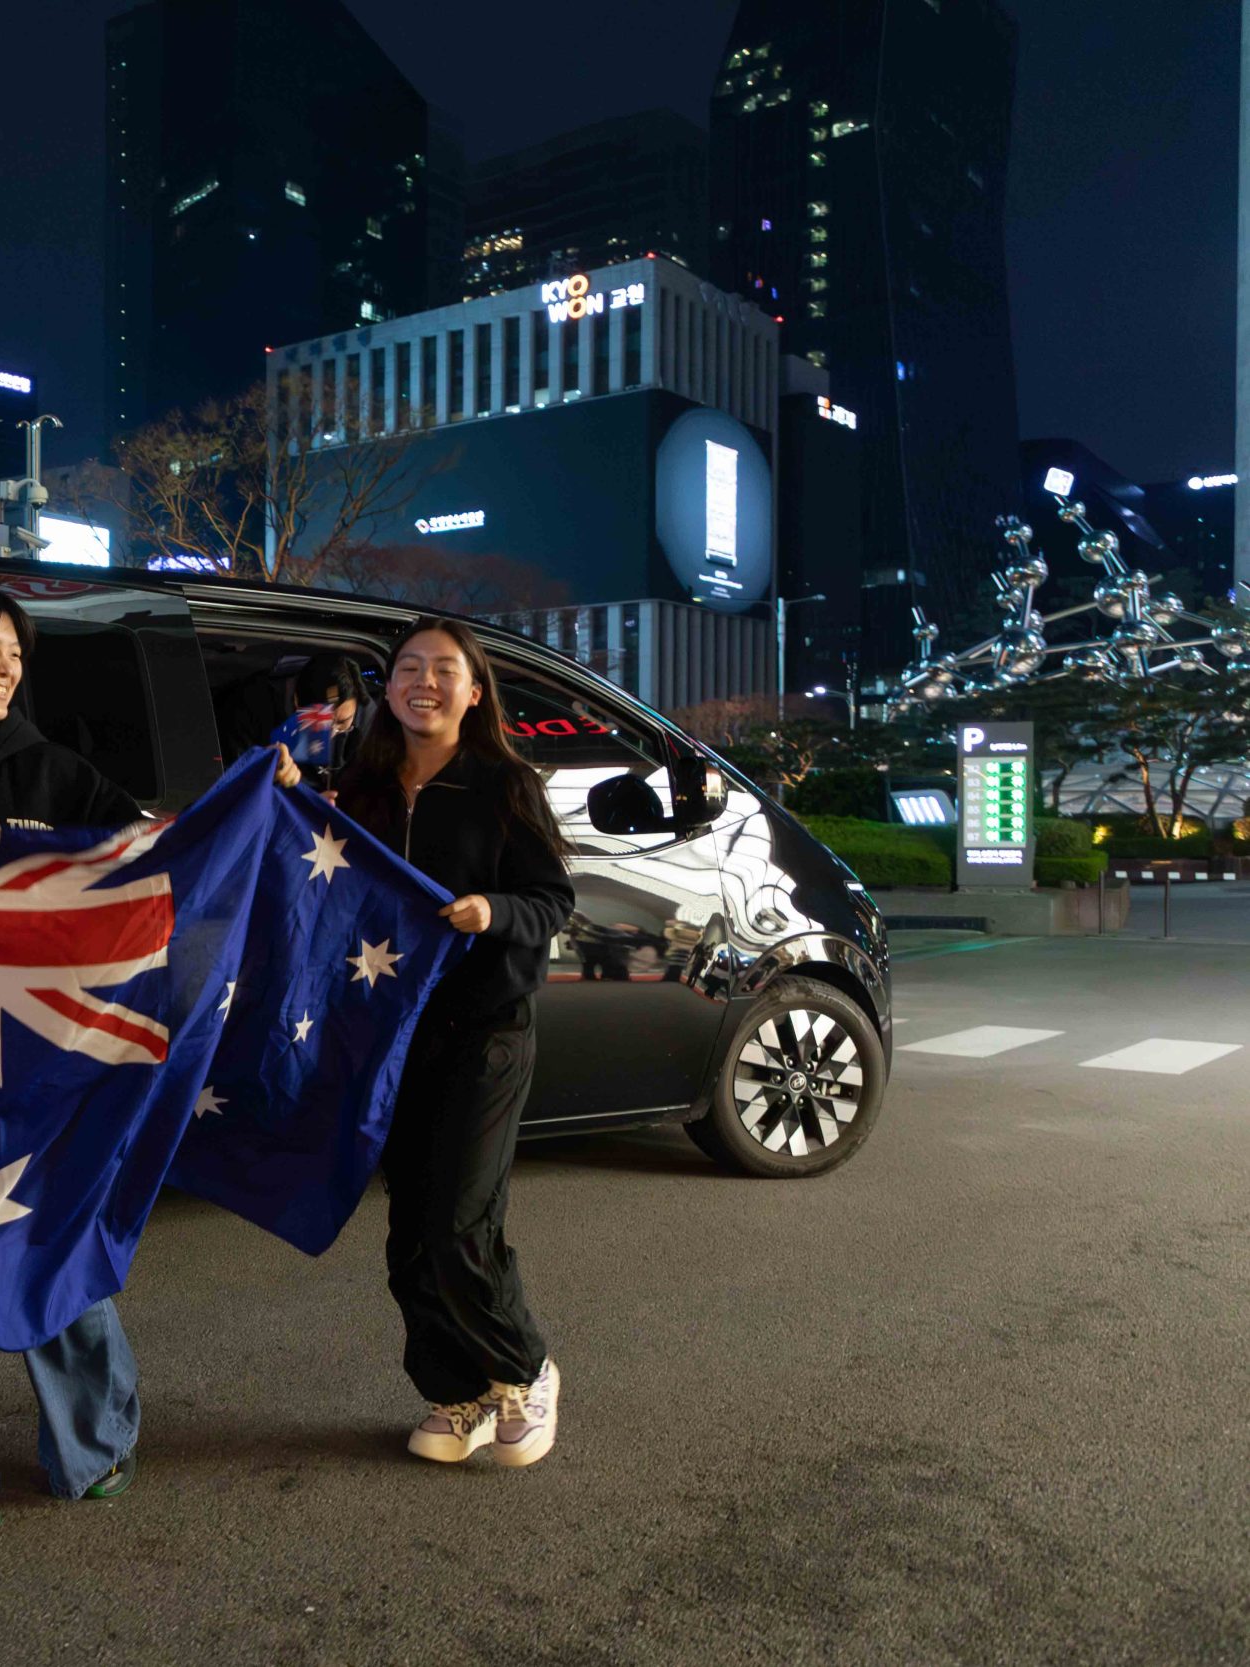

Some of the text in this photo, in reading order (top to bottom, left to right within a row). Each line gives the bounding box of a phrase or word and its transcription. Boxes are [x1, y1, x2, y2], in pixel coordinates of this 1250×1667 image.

[541, 274, 589, 303] KYO
[609, 283, 645, 310] 교원
[547, 293, 604, 323] WON
[963, 727, 985, 752] P
